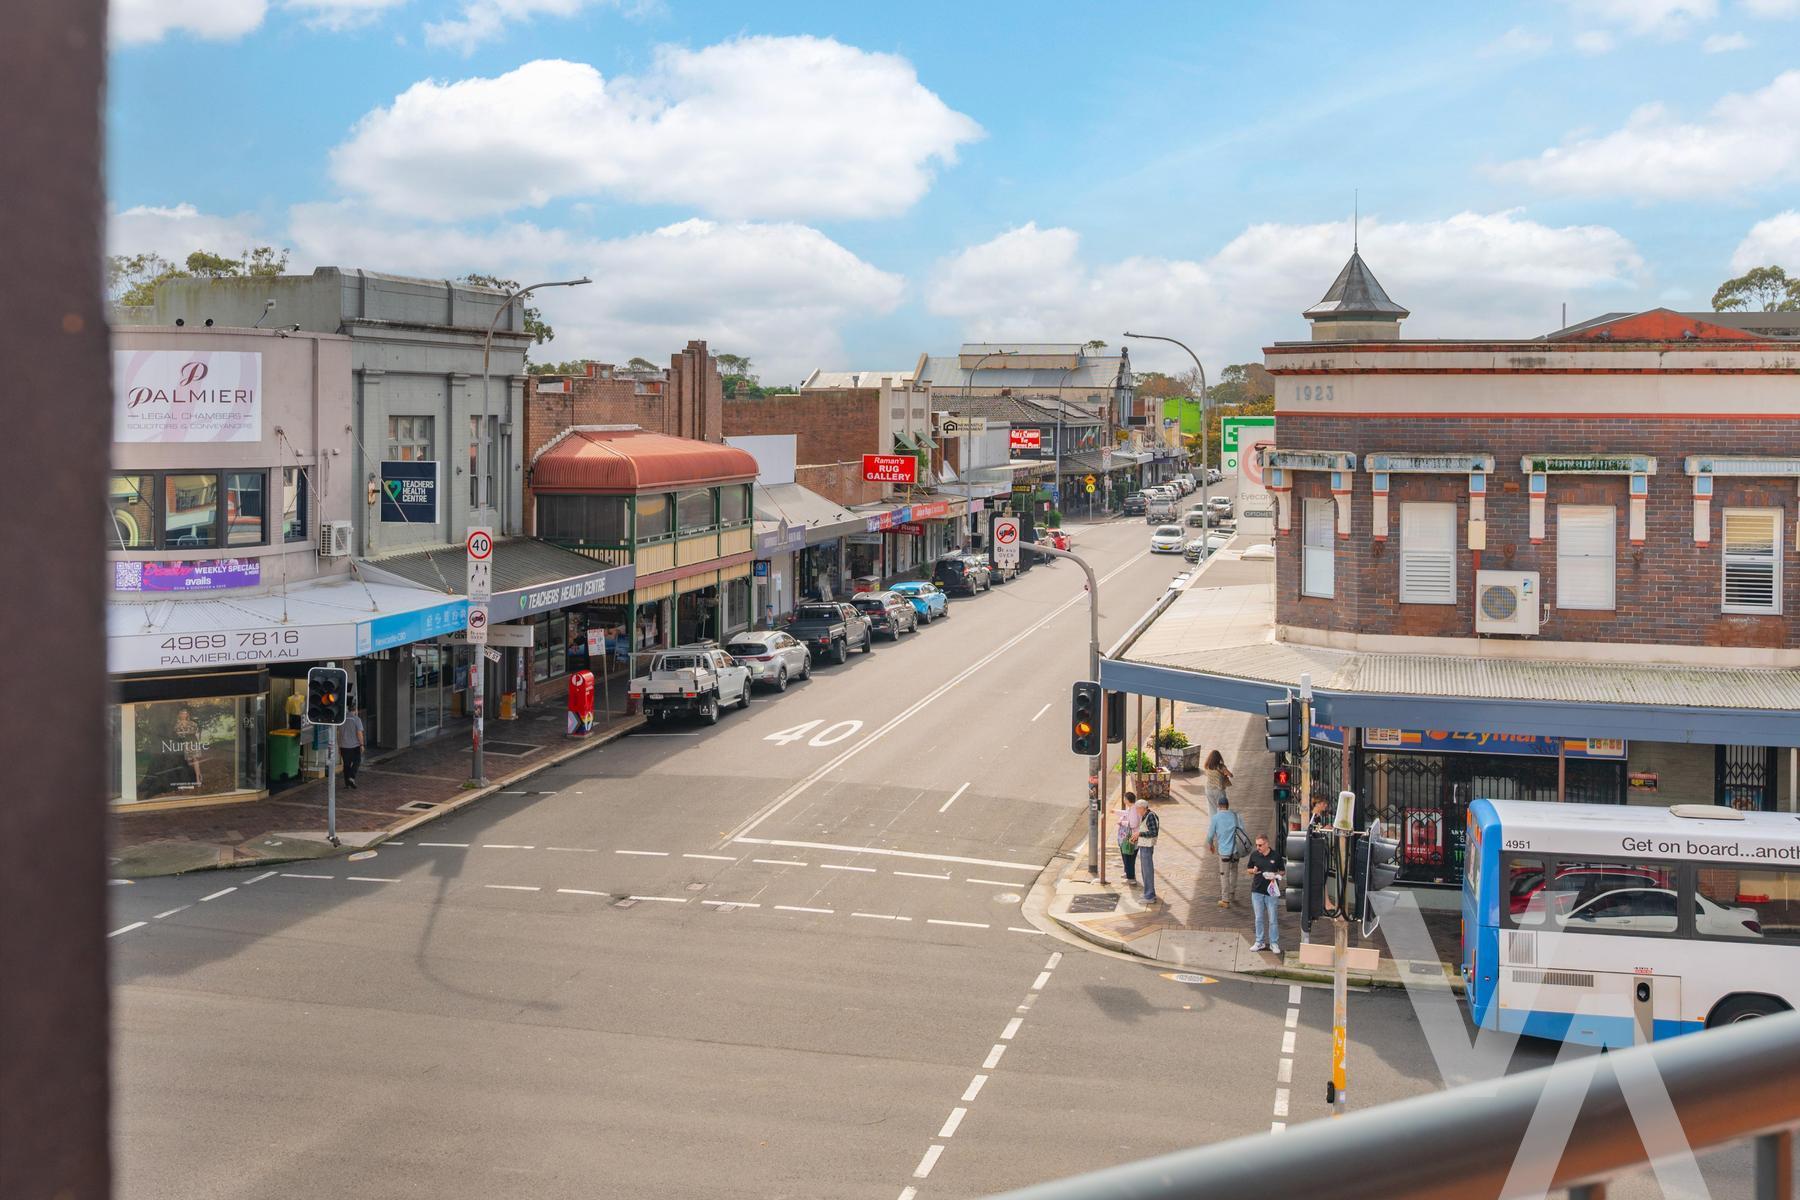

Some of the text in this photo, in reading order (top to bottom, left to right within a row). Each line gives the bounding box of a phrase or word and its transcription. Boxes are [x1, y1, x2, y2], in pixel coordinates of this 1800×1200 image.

[128, 386, 253, 408] PALMIERI
[141, 412, 241, 420] LEGAL CHAMBERS
[879, 465, 899, 473] RUG
[867, 473, 911, 481] GALLERY
[402, 480, 434, 488] TEACHERS
[402, 495, 427, 503] CENTRE
[472, 539, 488, 552] 40
[195, 565, 228, 575] WEEKLY
[228, 563, 260, 573] SPECIALS
[528, 577, 606, 609] TEACHERS HEALTH CENTRE
[161, 630, 299, 651] 4969 7816
[160, 648, 299, 665] PALMIERI.COM.AU
[763, 719, 864, 747] 40
[162, 739, 211, 753] Nurture
[1505, 840, 1532, 849] 4951
[1622, 837, 1654, 852] Get
[1659, 841, 1681, 853] on
